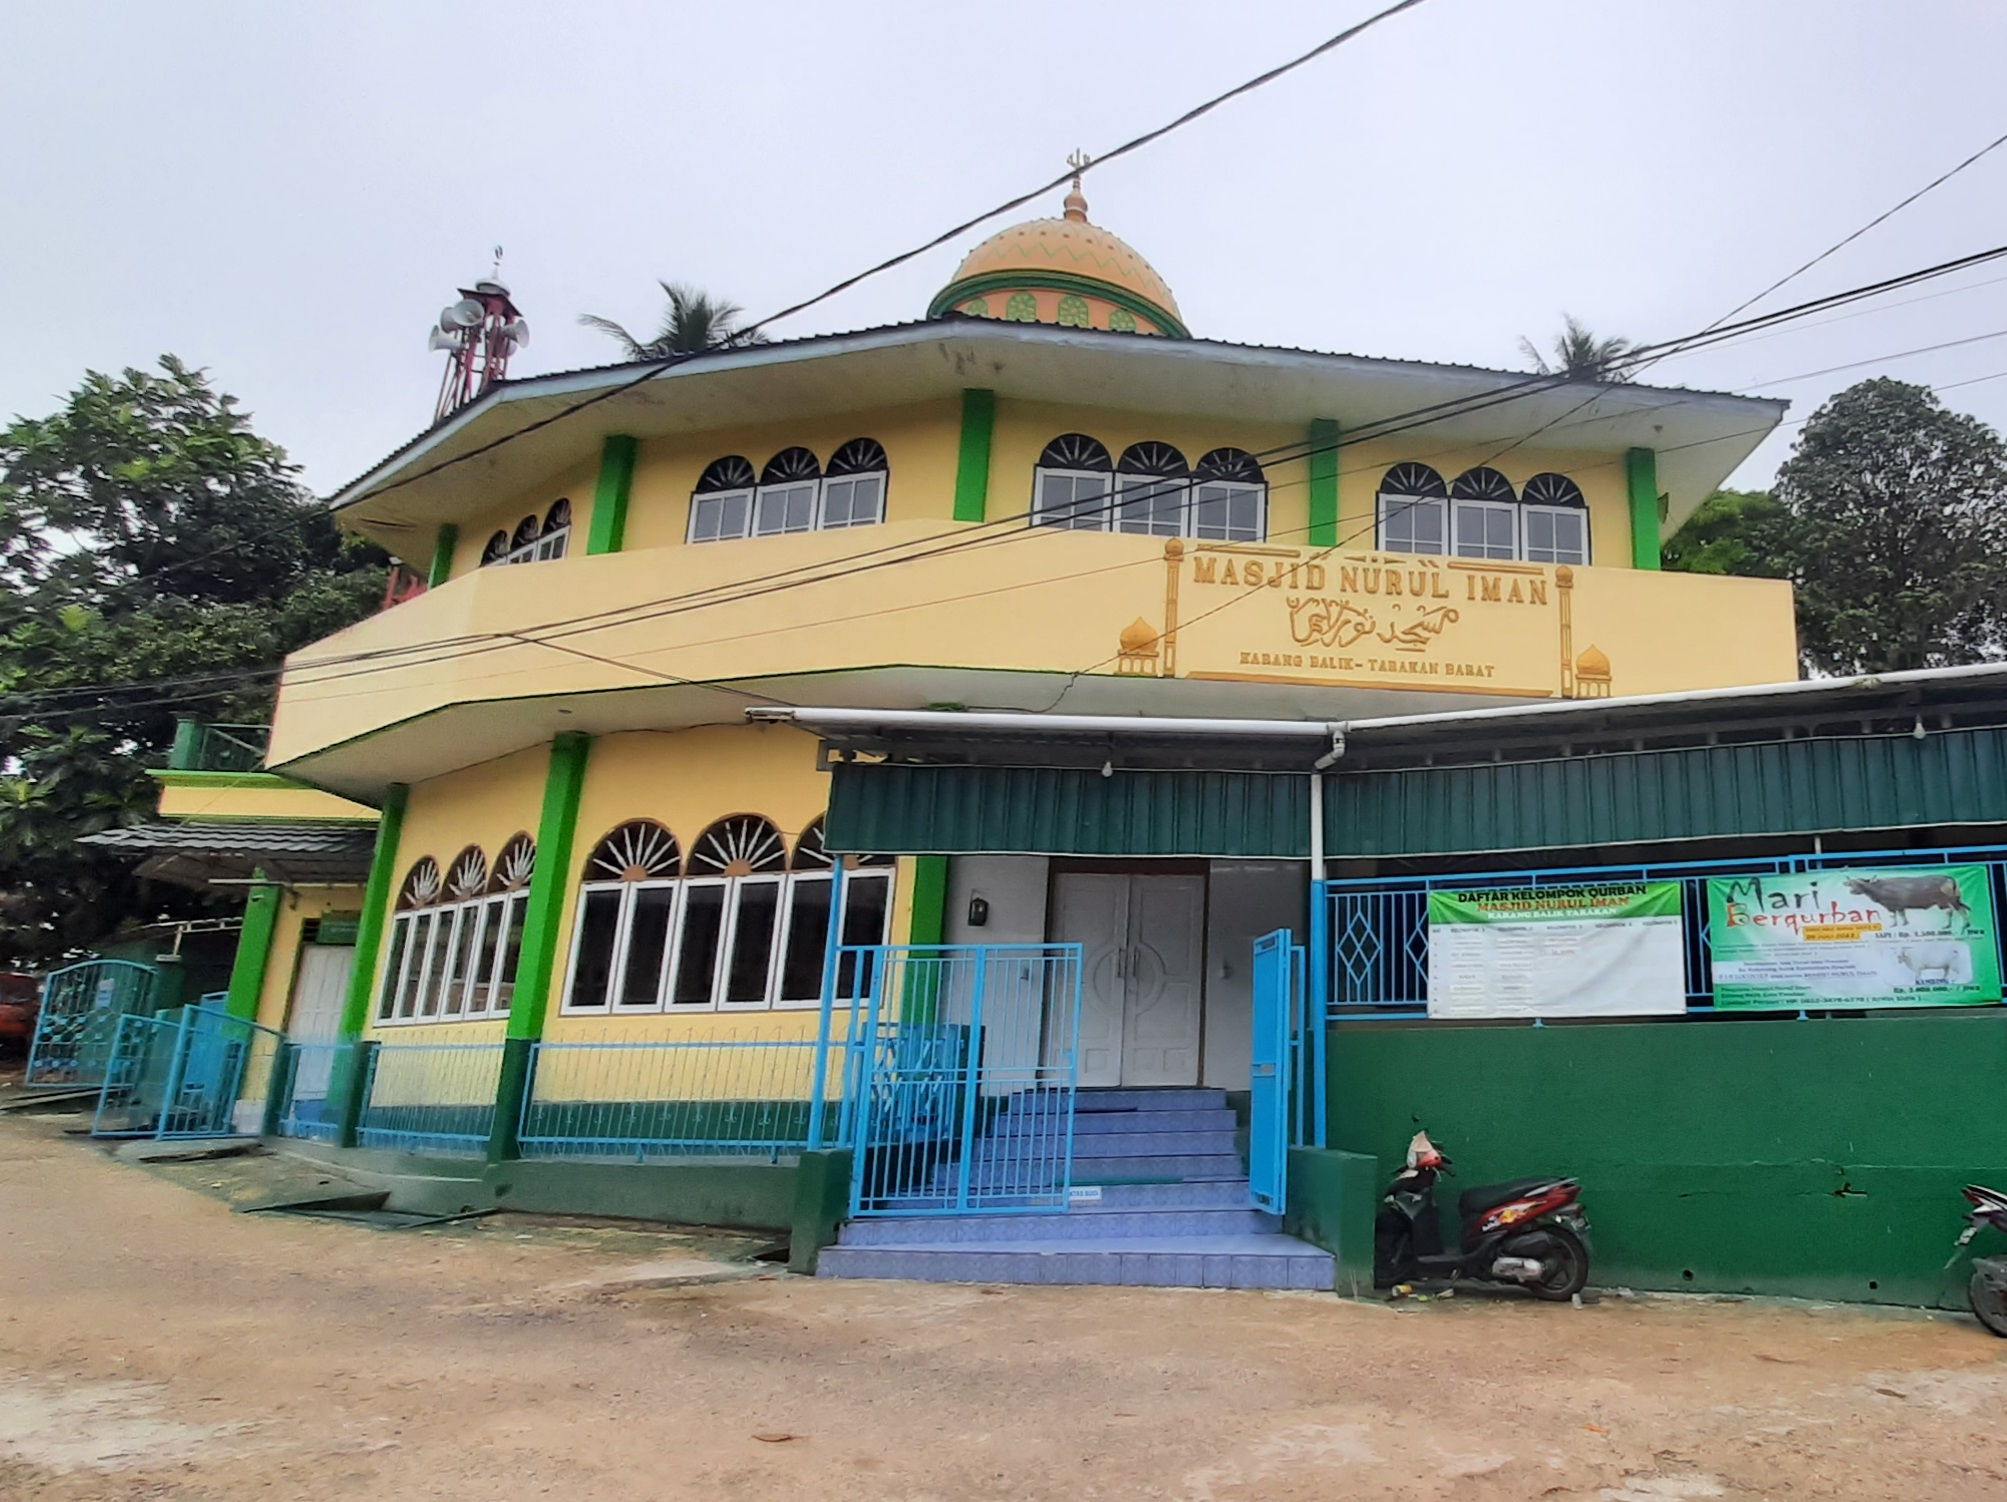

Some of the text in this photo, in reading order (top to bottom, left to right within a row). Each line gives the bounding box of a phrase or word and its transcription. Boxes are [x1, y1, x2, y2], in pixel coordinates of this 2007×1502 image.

[1193, 556, 1548, 605] MASJID NURUL IMAN
[1457, 885, 1647, 903] DAFTAR KELOMPOK QURBAN
[1477, 896, 1630, 911] MASJID NURUL IMAN
[1726, 877, 1820, 912] Mari
[1487, 907, 1618, 920] KARANG BALIK TARAKAN
[1726, 901, 1882, 935] Berqurban
